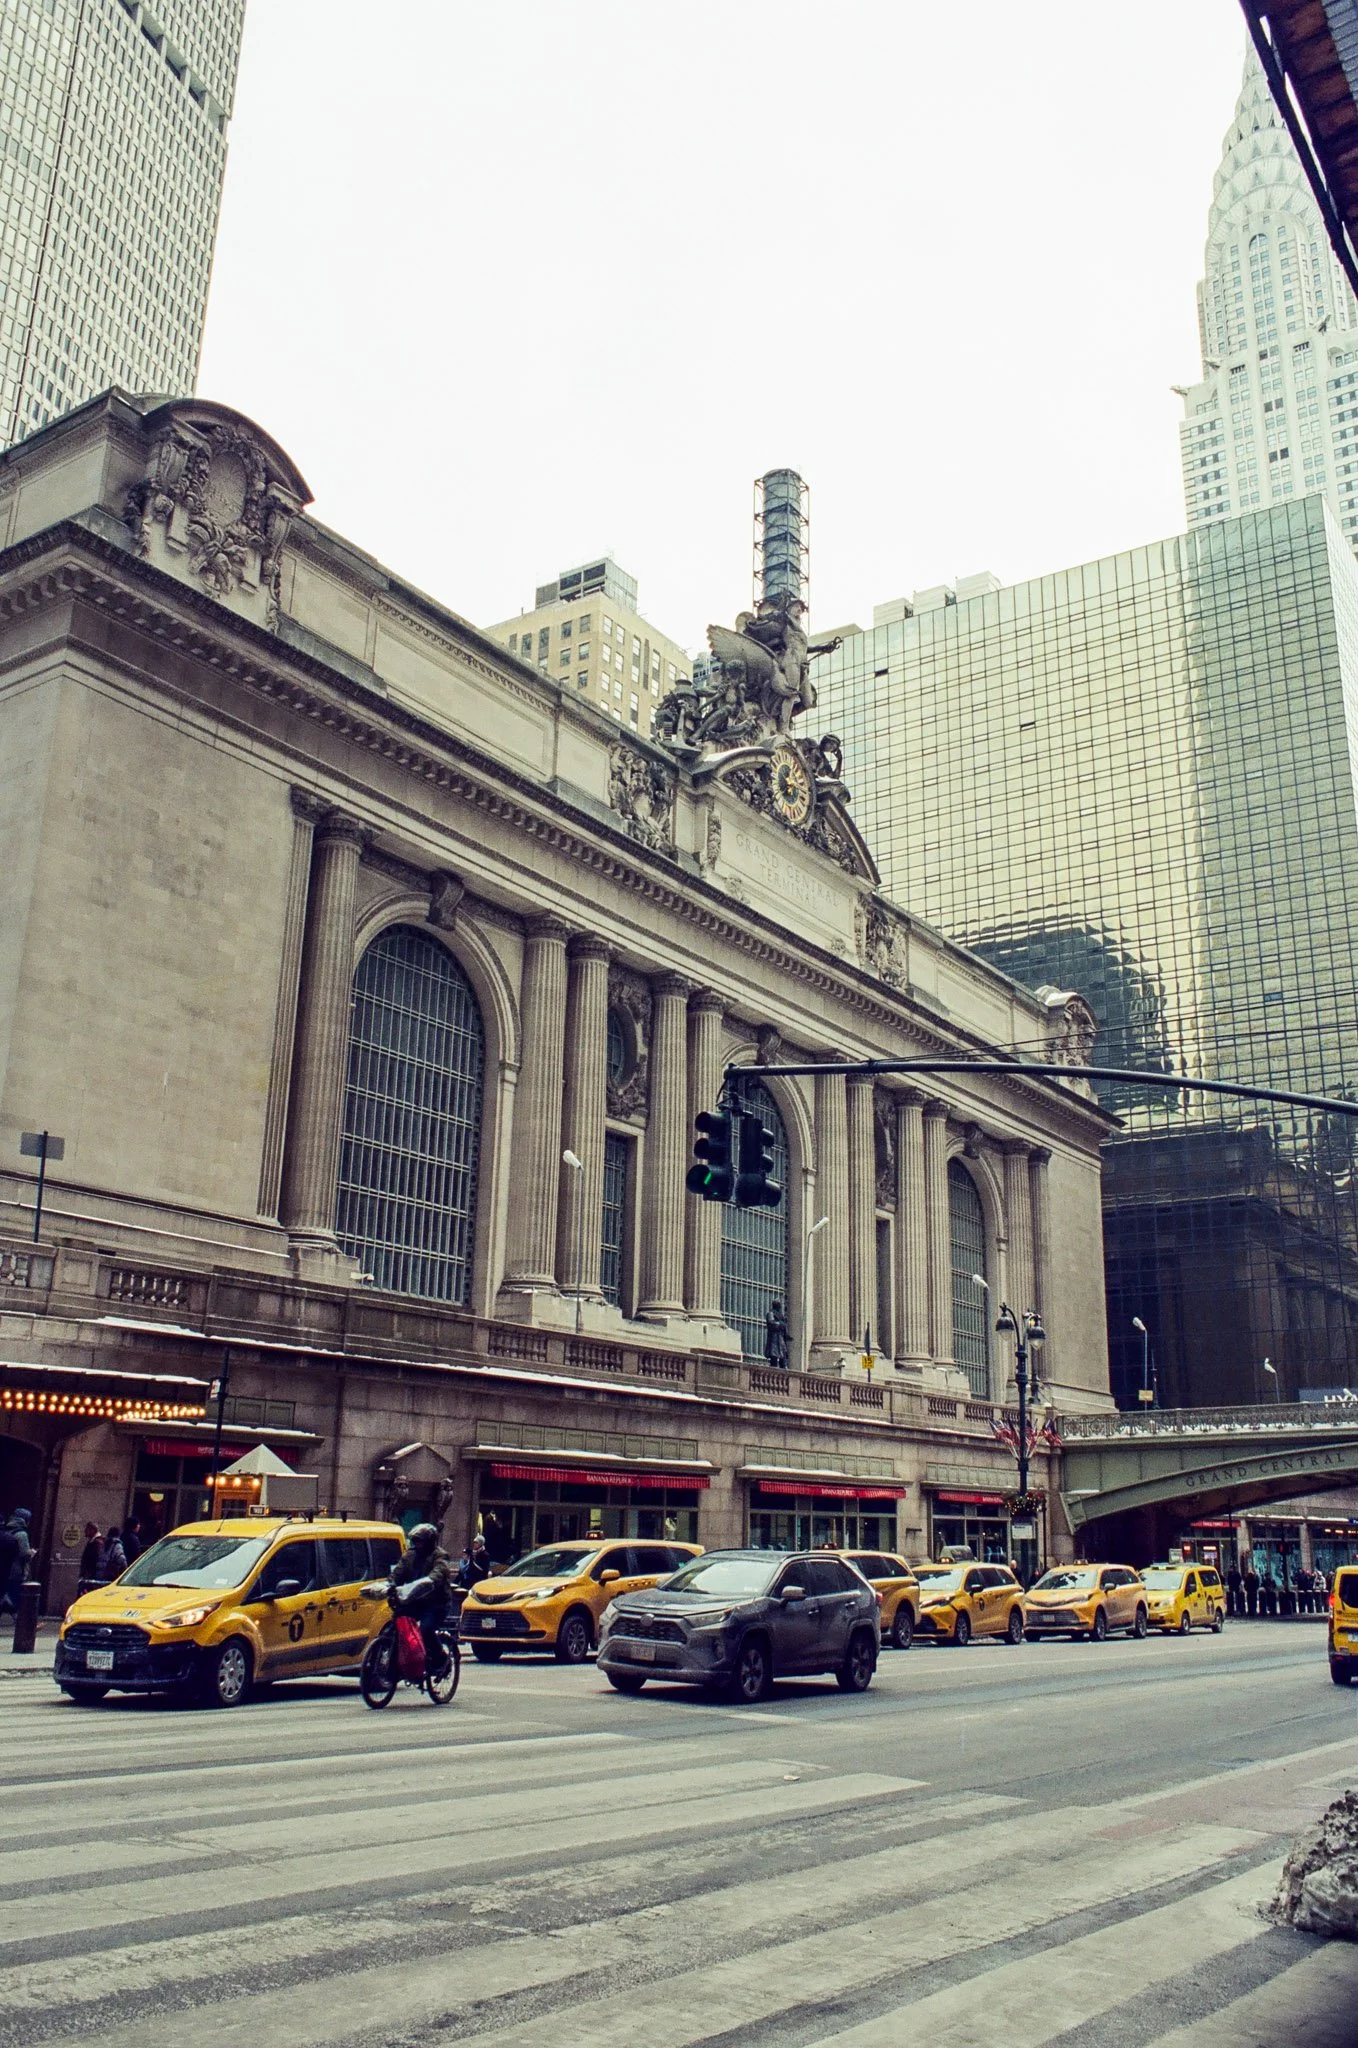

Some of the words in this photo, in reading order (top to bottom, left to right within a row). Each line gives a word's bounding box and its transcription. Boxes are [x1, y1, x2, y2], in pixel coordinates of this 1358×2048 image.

[736, 833, 779, 869] GRAND
[787, 864, 839, 908] CENTRAL
[586, 1474, 610, 1483] BANANA
[1186, 1467, 1248, 1488] GRAND
[1259, 1453, 1346, 1474] CENTRAL
